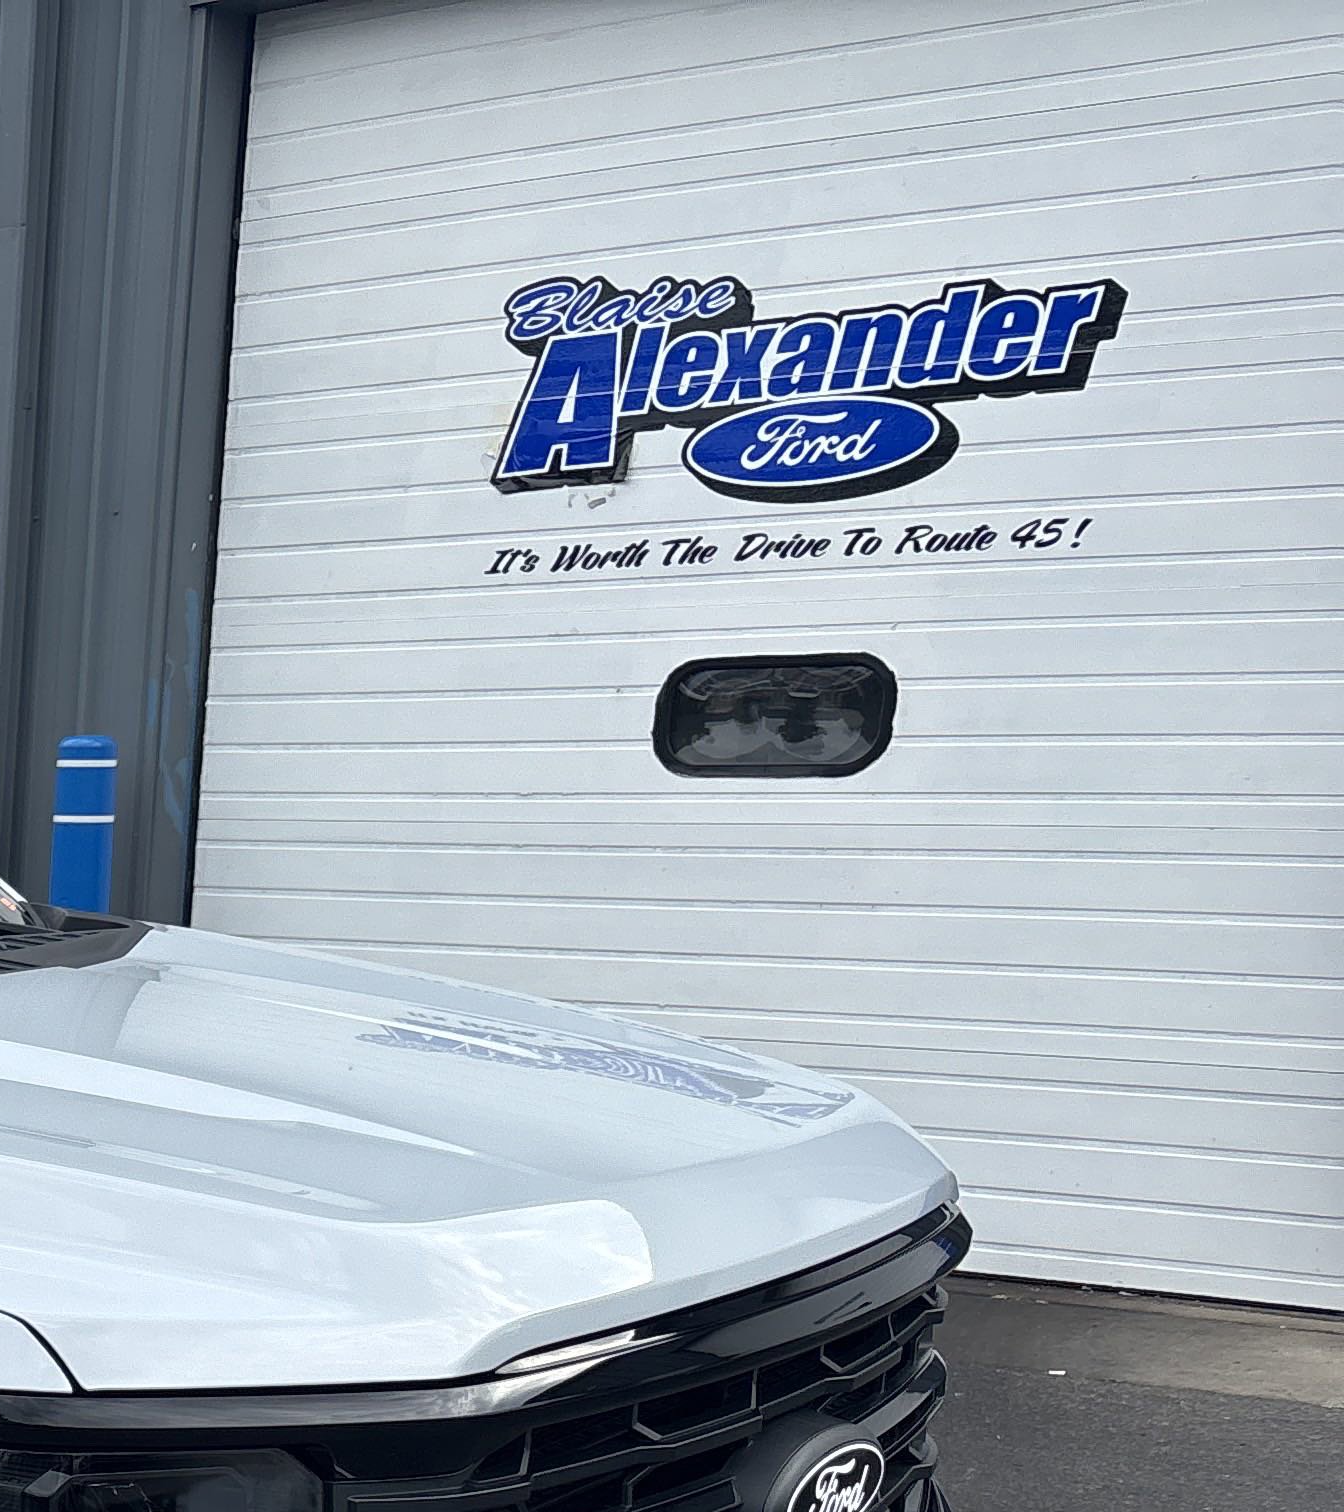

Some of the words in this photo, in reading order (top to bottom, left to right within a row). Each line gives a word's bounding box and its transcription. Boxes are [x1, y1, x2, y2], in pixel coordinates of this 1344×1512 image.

[511, 279, 737, 338] Blaise
[496, 285, 1105, 478] Alexander
[741, 411, 876, 470] Ford
[484, 548, 540, 574] It's
[550, 540, 650, 572] Worth
[662, 536, 718, 566] The
[734, 533, 831, 561] Drive
[843, 528, 883, 556] To
[894, 525, 998, 554] Route
